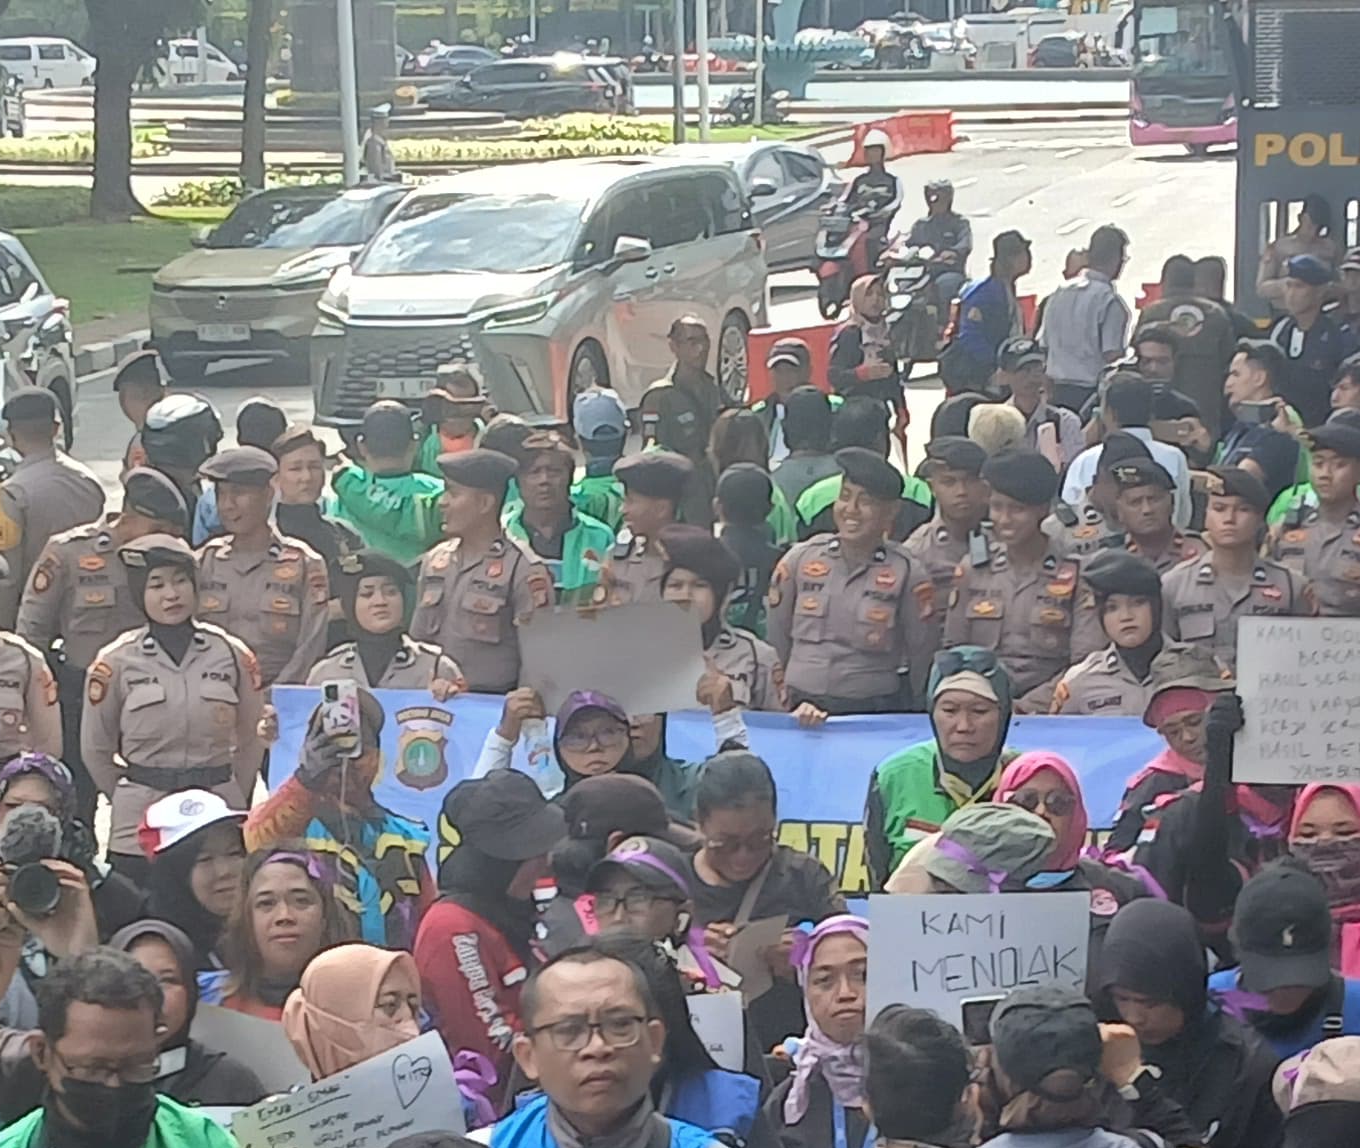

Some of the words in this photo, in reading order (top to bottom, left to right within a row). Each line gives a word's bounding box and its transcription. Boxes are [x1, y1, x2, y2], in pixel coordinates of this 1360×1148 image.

[1257, 626, 1301, 643] KAMI
[921, 910, 1006, 939] KAMI
[911, 945, 1084, 992] MENOLAK
